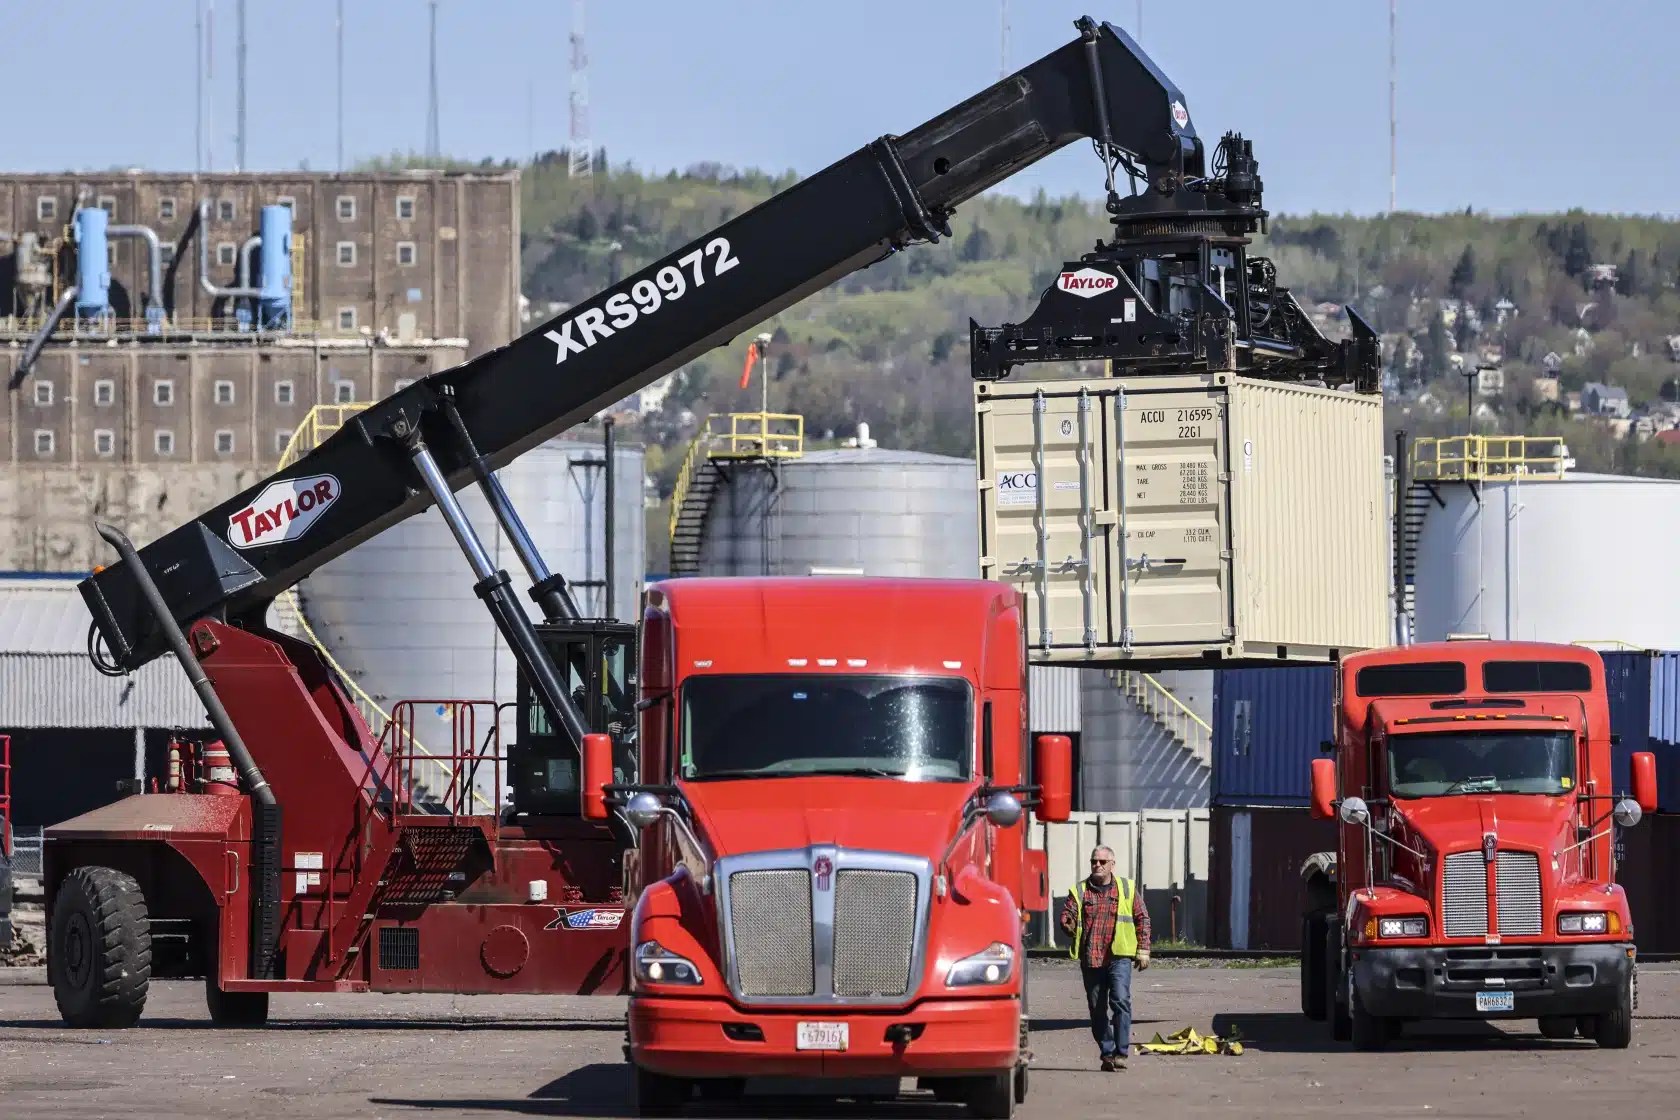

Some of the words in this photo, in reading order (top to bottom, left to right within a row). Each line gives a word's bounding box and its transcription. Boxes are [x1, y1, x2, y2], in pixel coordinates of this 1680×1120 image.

[1062, 273, 1115, 289] TAYLOR
[543, 237, 740, 365] XRS9972
[1140, 410, 1165, 424] ACCU
[1177, 408, 1213, 422] 216595
[1178, 425, 1201, 438] 22G1
[1151, 463, 1168, 471] GROSS
[1136, 491, 1146, 499] NET
[231, 480, 334, 543] TAYLOR
